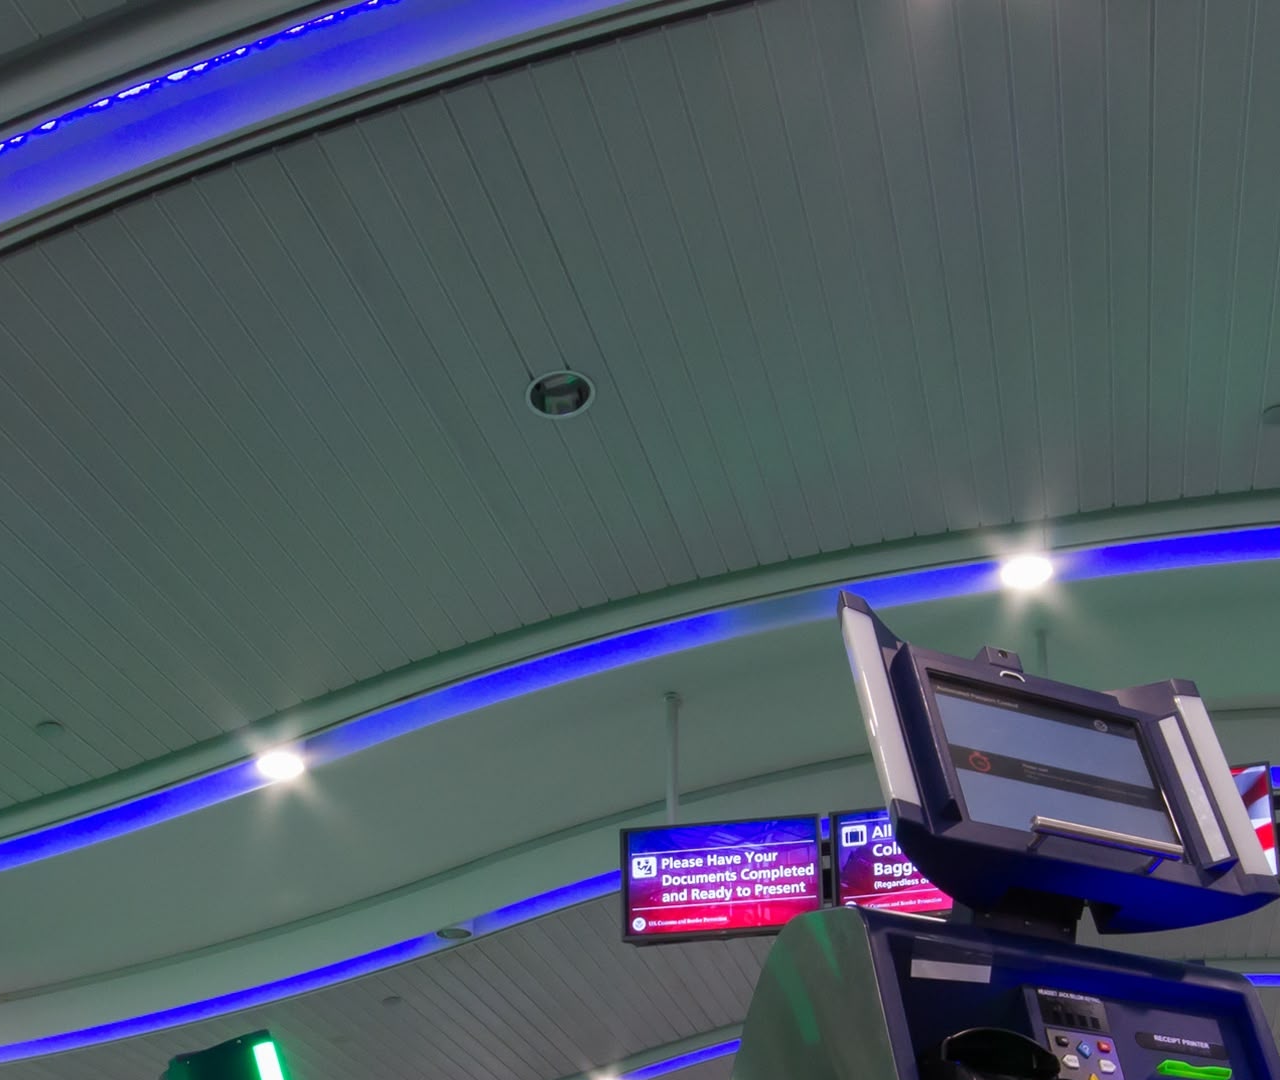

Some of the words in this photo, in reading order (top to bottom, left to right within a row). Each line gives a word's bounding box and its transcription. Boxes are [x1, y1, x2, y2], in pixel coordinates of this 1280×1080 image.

[872, 823, 892, 839] All
[872, 841, 902, 857] Coll
[661, 856, 703, 870] Please
[707, 853, 742, 867] Have
[744, 850, 779, 864] Your
[661, 869, 738, 887] Documents
[740, 863, 815, 883] Completed
[873, 861, 918, 877] Bagg
[661, 889, 688, 903] and
[691, 886, 734, 902] Ready
[736, 885, 752, 897] to
[754, 881, 807, 896] Present
[874, 878, 919, 890] (Regardless
[1153, 1034, 1181, 1045] RECEIPT
[1182, 1038, 1210, 1050] PRINTER
